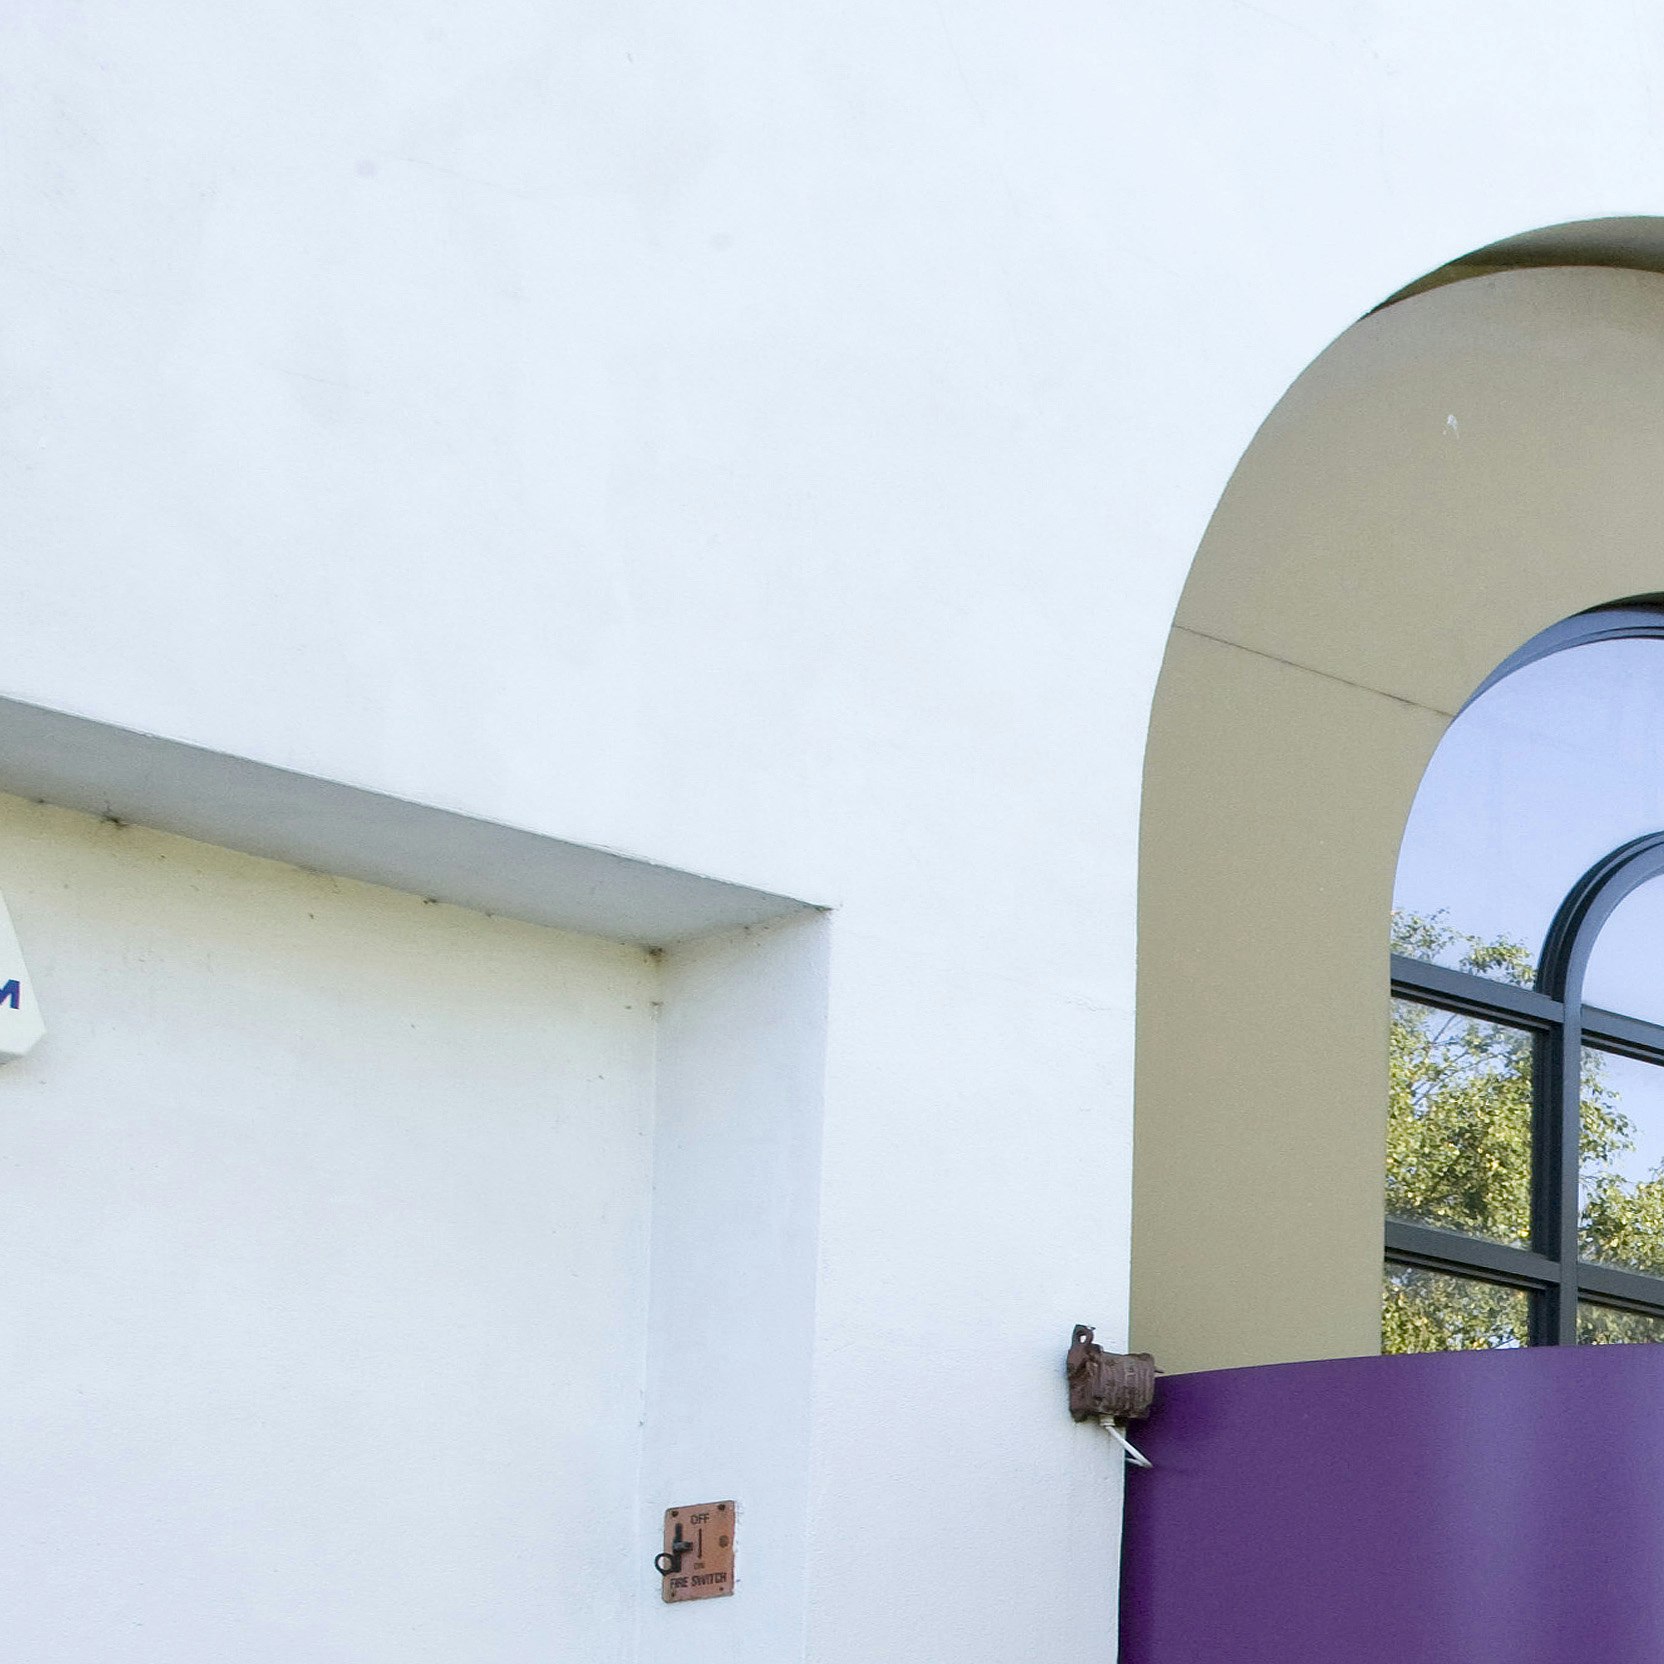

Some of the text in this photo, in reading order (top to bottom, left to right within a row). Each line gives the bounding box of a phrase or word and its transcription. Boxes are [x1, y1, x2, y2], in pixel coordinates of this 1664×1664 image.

[690, 1513, 710, 1525] OFF
[693, 1562, 706, 1570] ON
[670, 1573, 727, 1589] FIRE SWITCH
